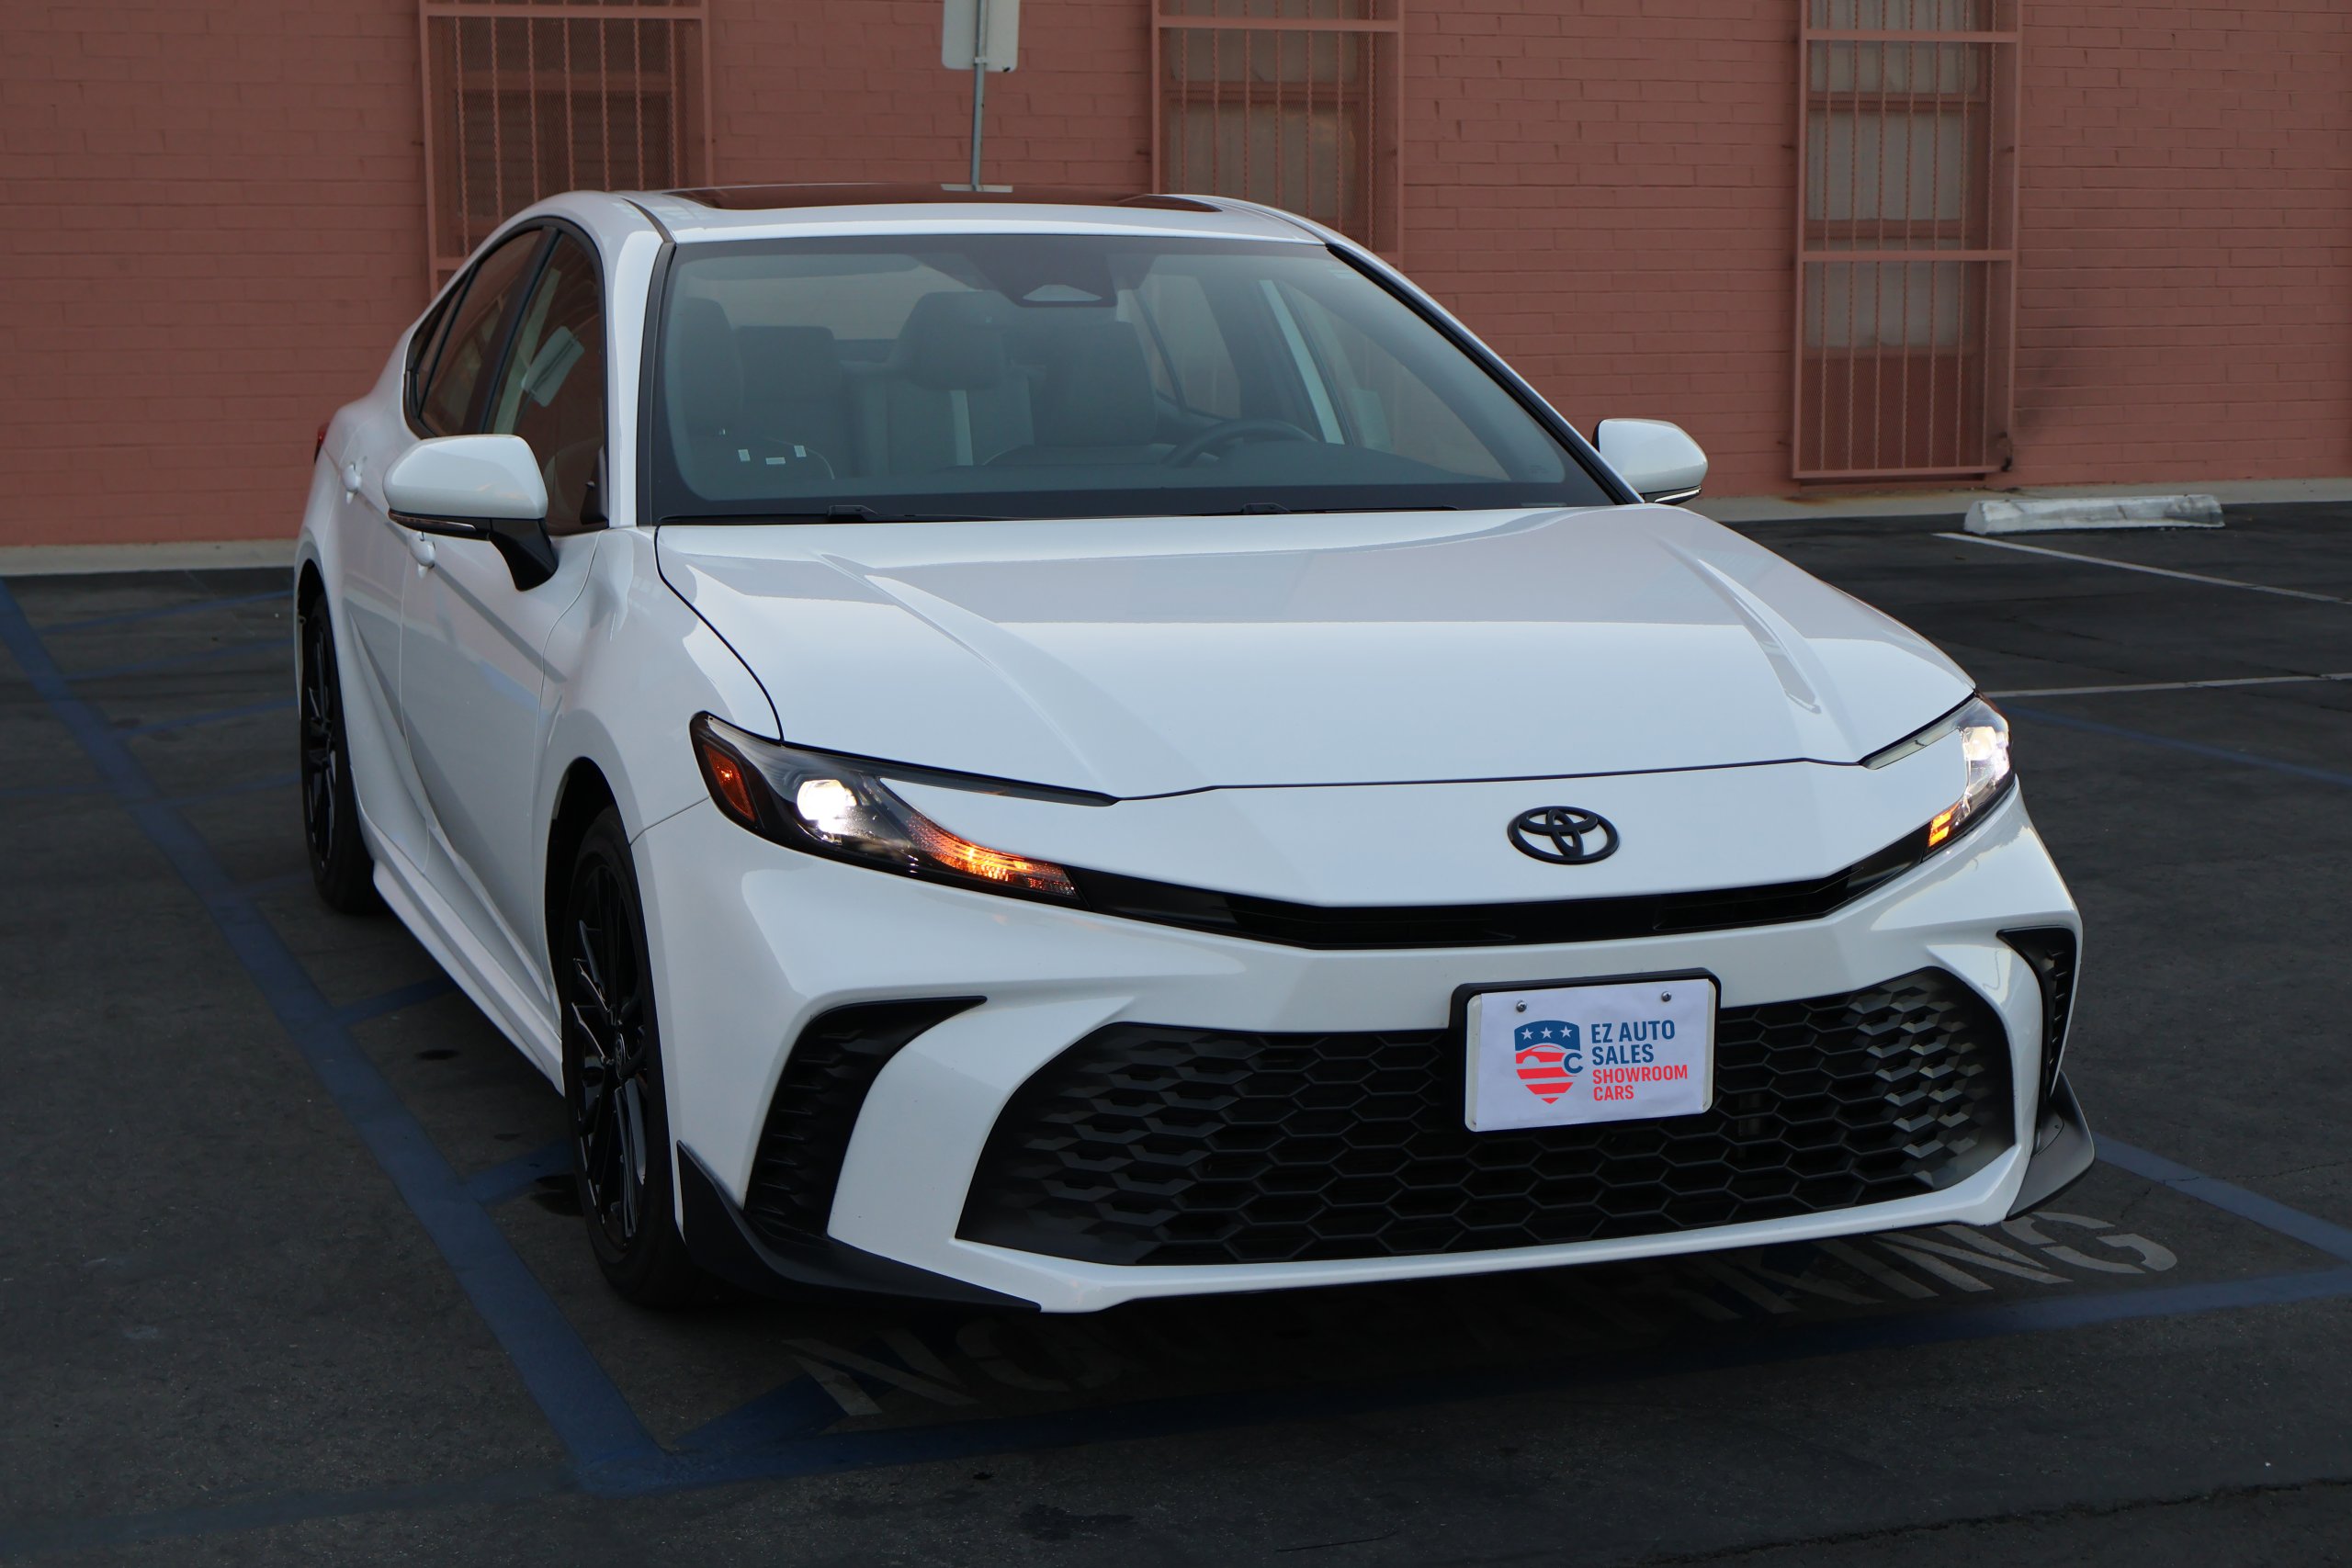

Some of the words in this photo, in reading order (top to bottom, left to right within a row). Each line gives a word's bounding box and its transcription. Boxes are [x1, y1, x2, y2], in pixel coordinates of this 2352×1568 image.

[1591, 1023, 1613, 1043] EZ
[1619, 1020, 1676, 1043] AUTO
[1592, 1043, 1655, 1066] SALES
[1592, 1065, 1688, 1085] SHOWROOM
[1593, 1086, 1634, 1101] CARS
